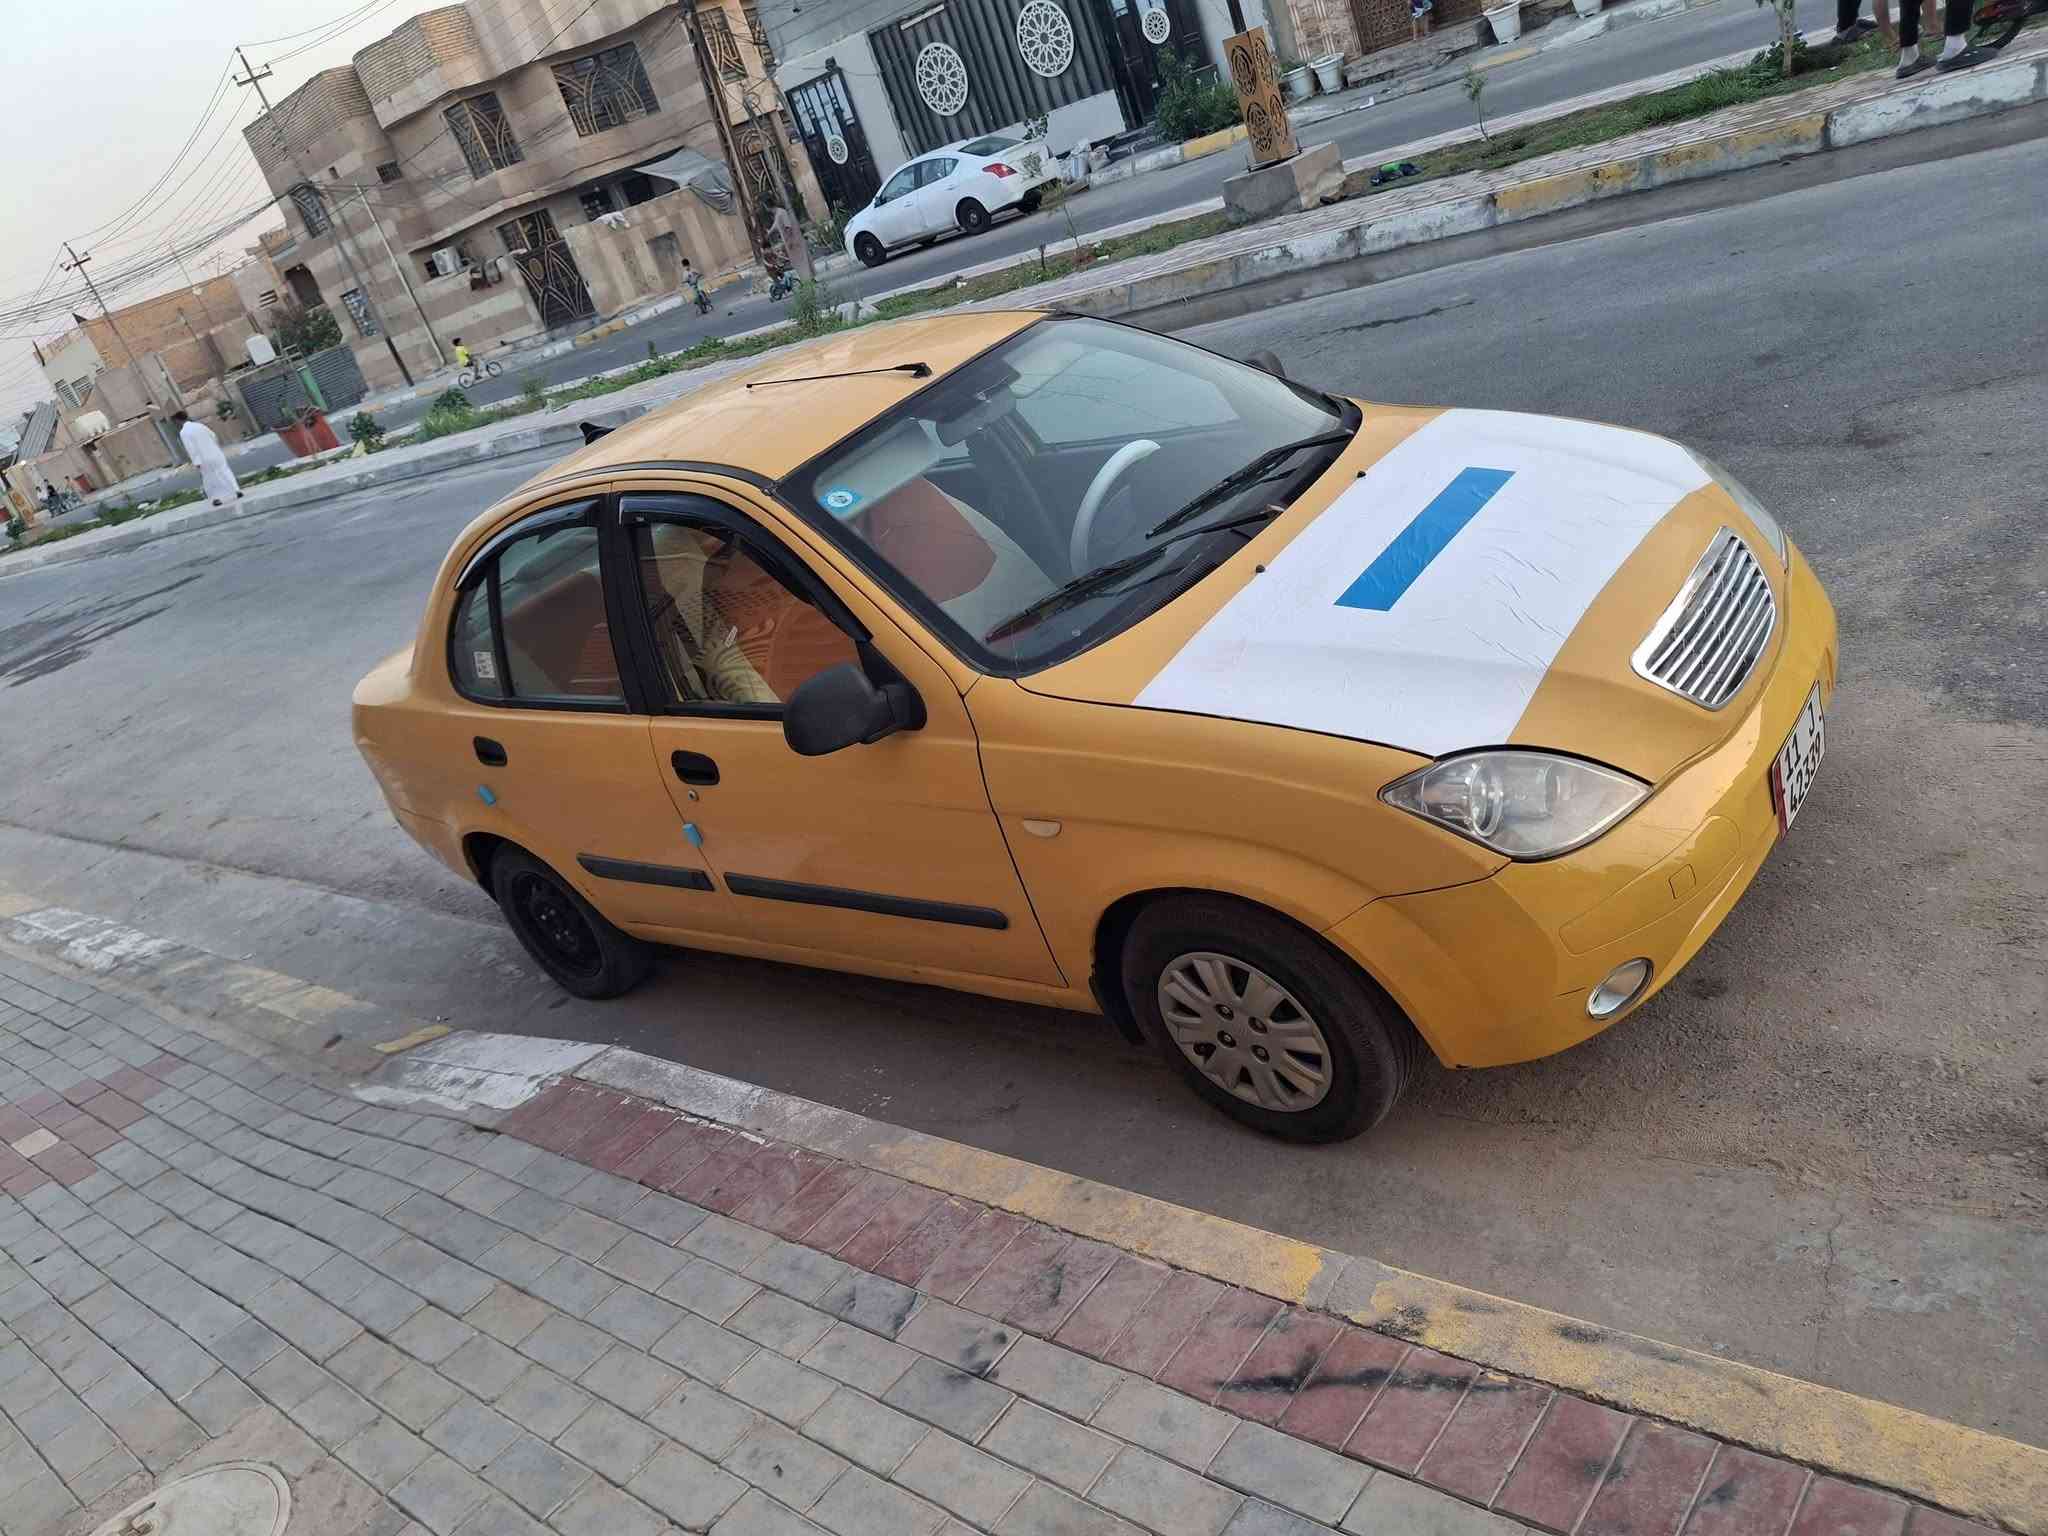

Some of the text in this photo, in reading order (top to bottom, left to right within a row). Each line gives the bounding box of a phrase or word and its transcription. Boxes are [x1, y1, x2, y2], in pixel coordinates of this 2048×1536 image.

[1785, 702, 1815, 781] 11 J
[1790, 731, 1821, 812] 42339
